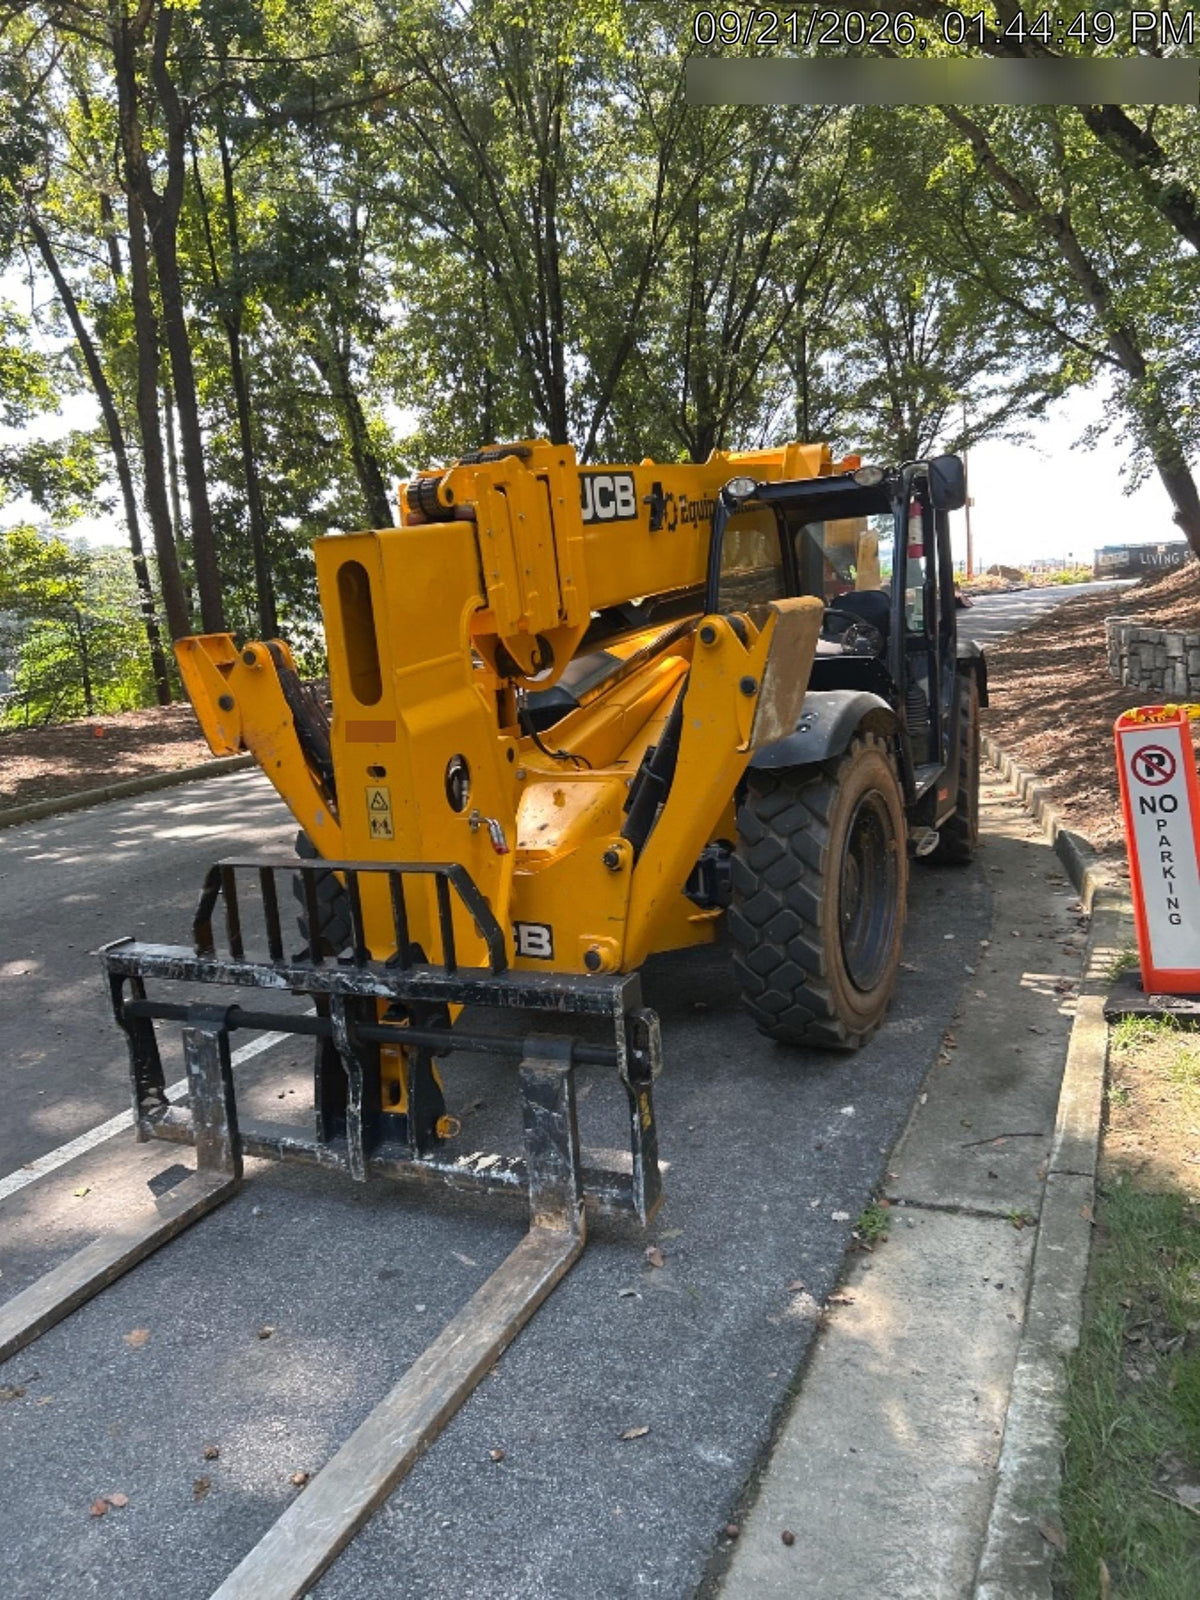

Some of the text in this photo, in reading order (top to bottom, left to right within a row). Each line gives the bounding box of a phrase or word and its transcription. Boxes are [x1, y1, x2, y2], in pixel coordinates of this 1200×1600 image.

[581, 476, 636, 520] JCB
[679, 493, 717, 528] Equip
[1140, 552, 1180, 565] LIVING
[1139, 794, 1179, 815] NO
[1156, 819, 1182, 926] PARKING
